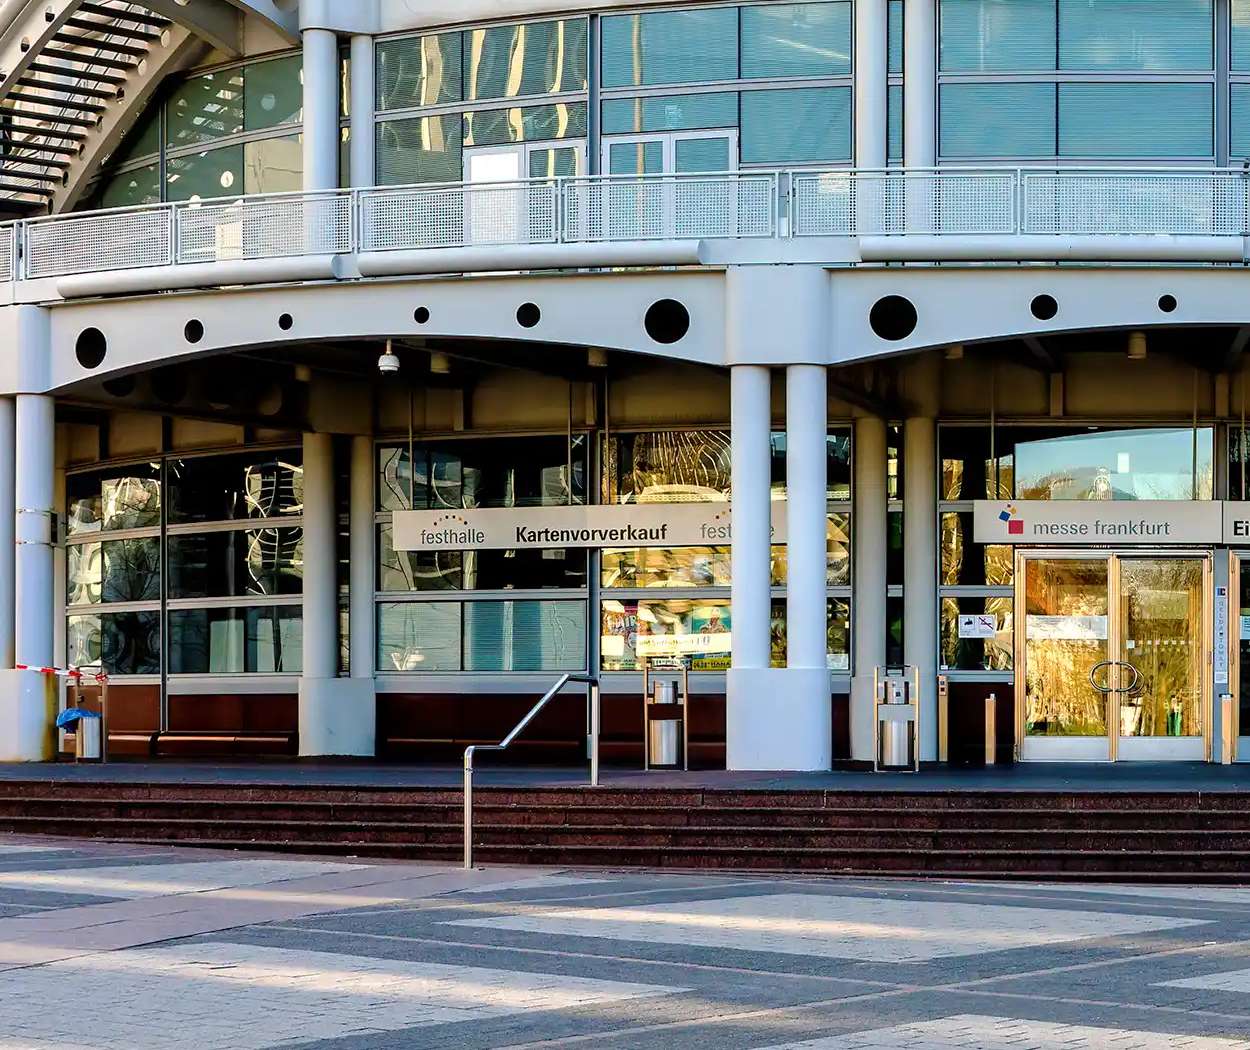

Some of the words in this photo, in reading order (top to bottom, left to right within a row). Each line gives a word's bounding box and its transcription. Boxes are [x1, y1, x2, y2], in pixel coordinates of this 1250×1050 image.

[515, 523, 668, 543] Kartenvorverkauf
[1033, 523, 1088, 536] messe
[1094, 519, 1170, 536] frankfurt
[420, 528, 485, 545] festhalle
